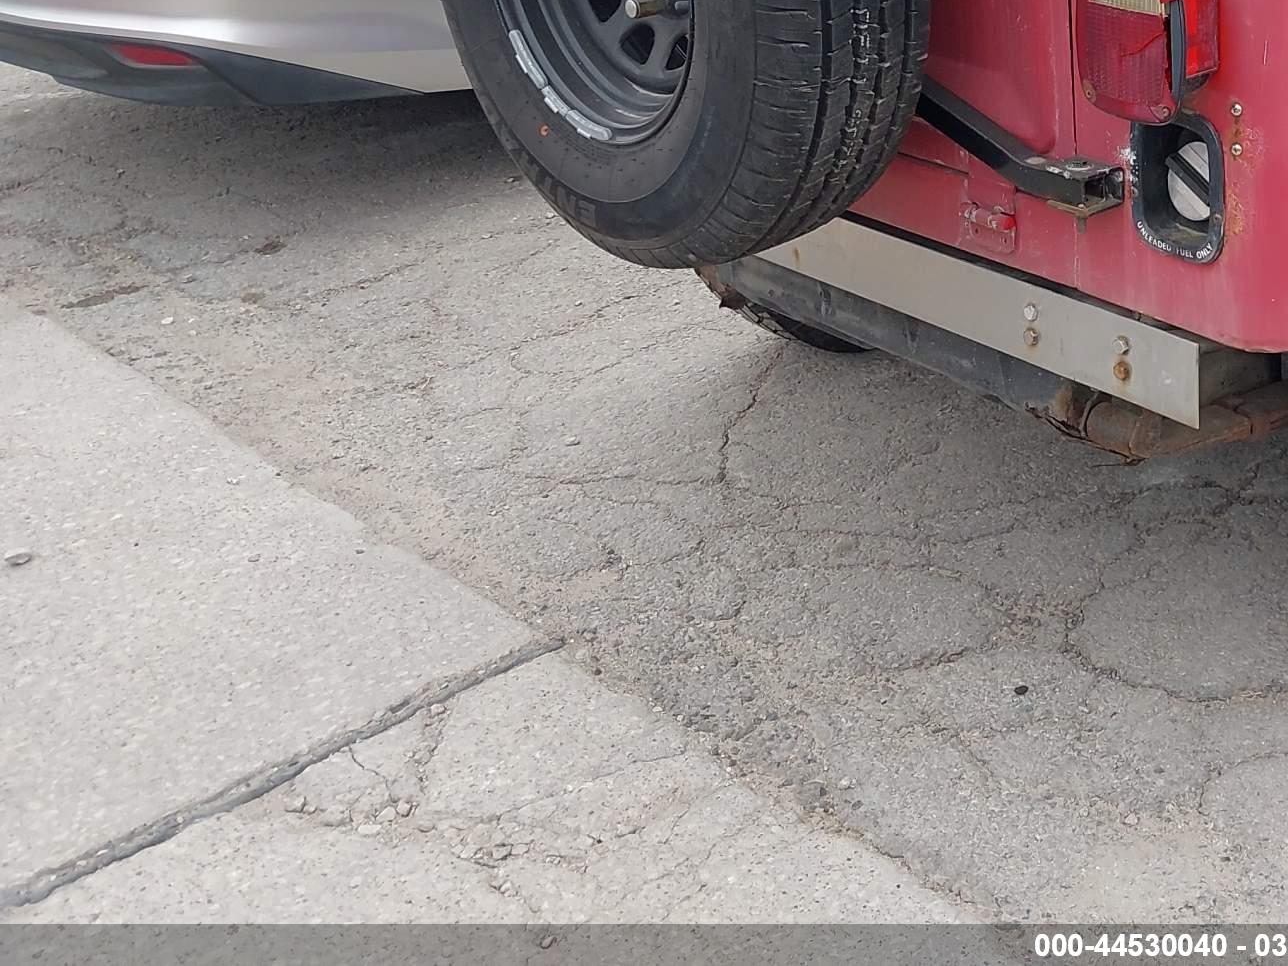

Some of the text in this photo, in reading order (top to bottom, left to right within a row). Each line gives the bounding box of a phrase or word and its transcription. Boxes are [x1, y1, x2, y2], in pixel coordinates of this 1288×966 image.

[1137, 221, 1213, 259] UNLEADED FUEL ONLY
